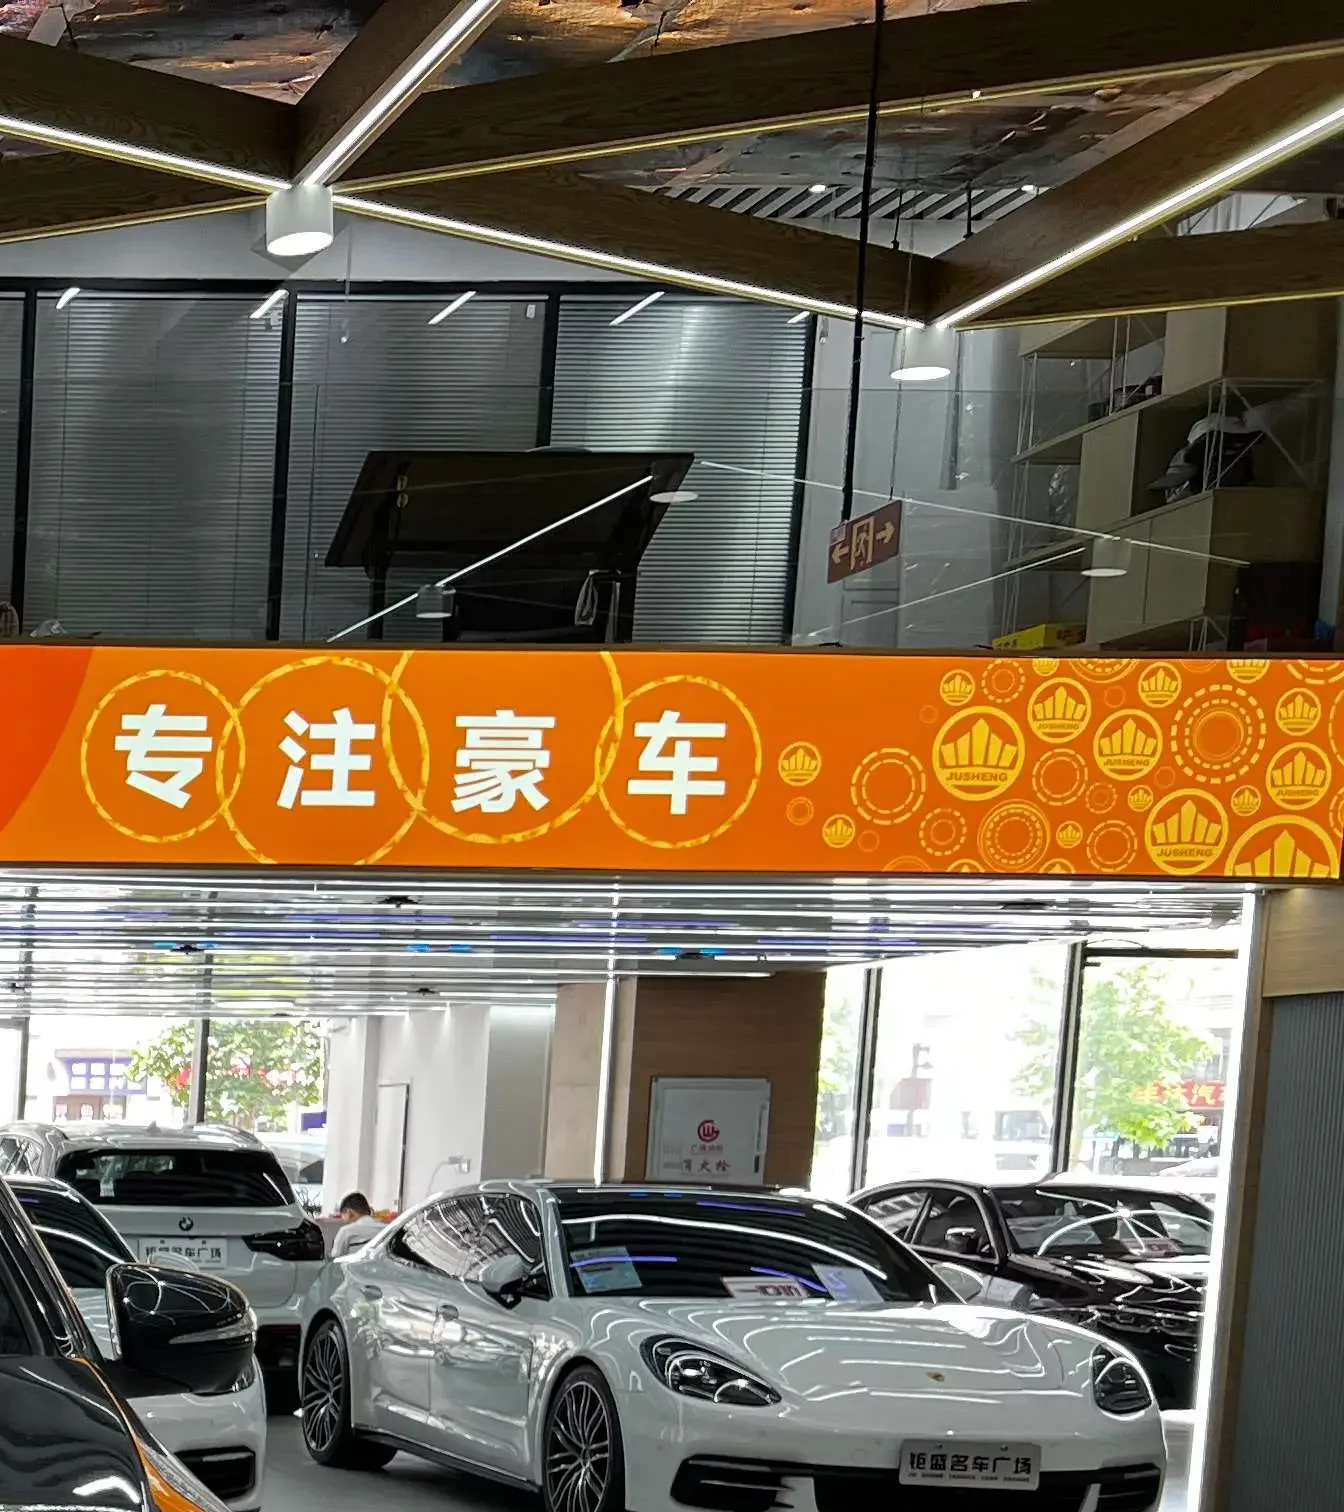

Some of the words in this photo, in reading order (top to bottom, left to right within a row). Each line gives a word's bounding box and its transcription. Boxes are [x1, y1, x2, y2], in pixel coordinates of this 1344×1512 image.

[114, 703, 727, 815] 专注豪车
[946, 771, 1008, 783] JUSHENG
[1156, 848, 1213, 858] JUSHENG
[909, 1452, 1032, 1475] 钜盛名车广场
